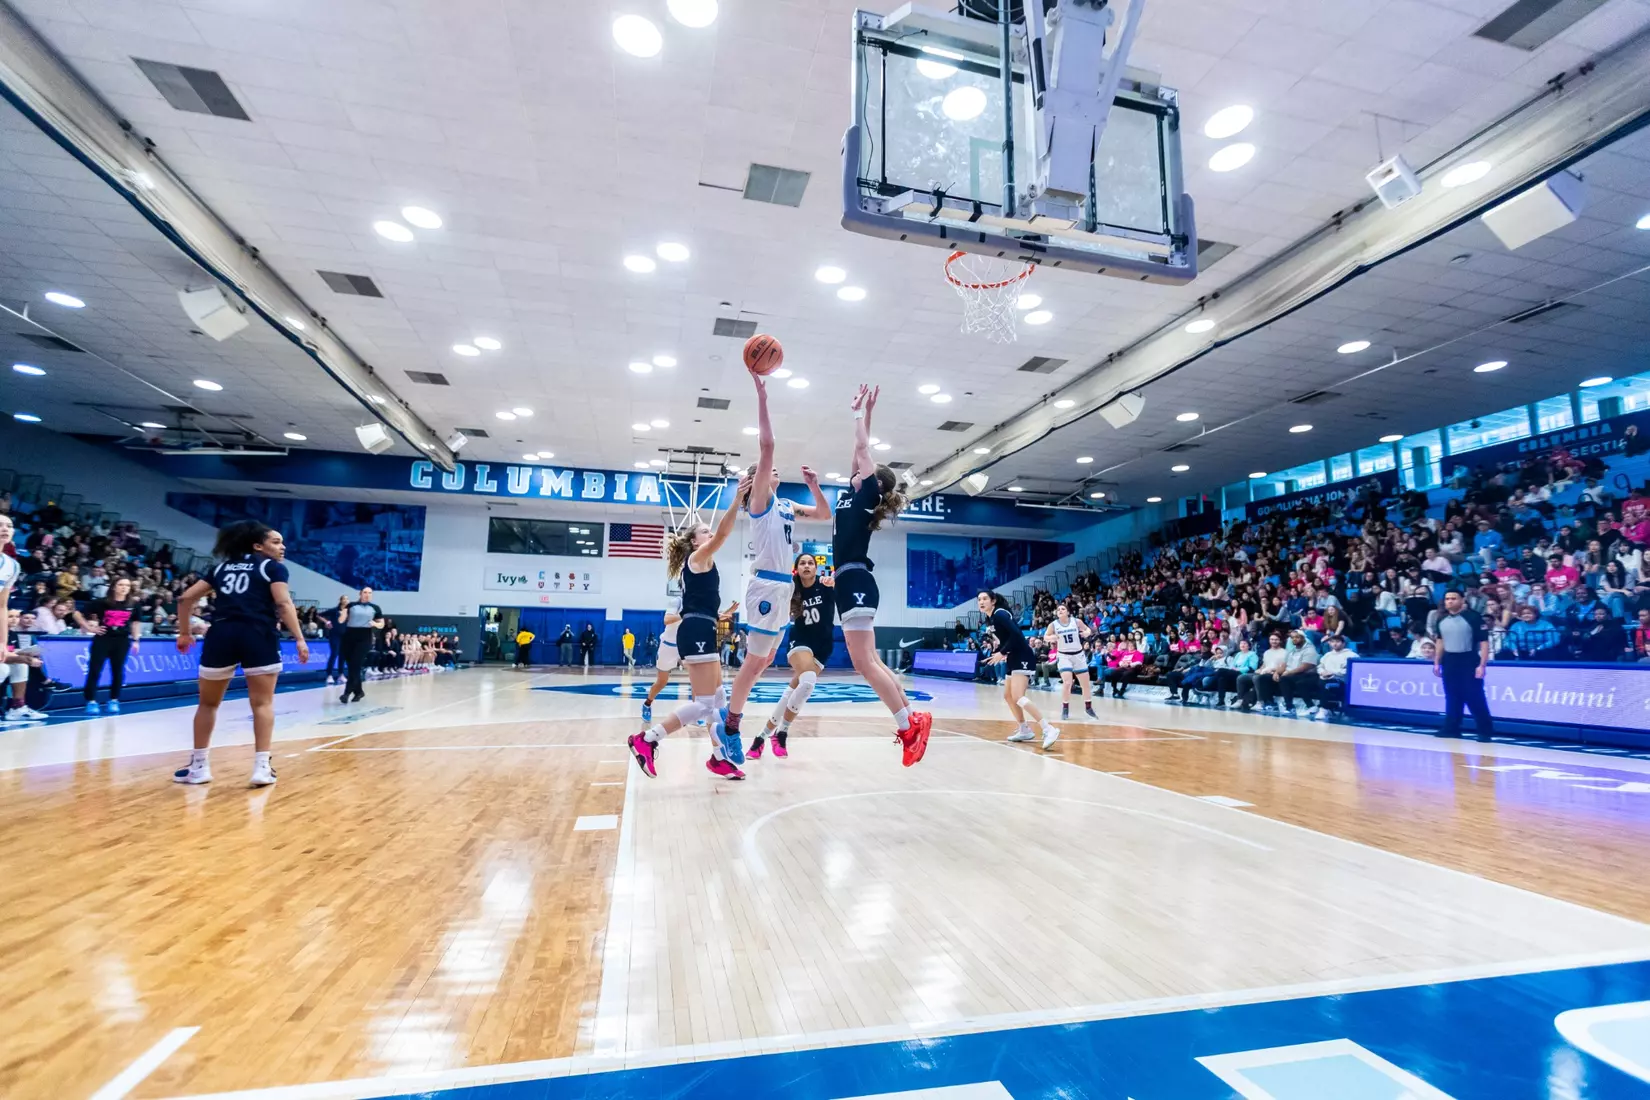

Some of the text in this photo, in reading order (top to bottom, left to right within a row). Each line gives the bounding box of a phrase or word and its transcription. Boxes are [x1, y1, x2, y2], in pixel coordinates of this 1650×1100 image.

[1518, 423, 1612, 453] COLUMBIA
[410, 460, 661, 502] COLUMBIA
[902, 494, 952, 513] ERE.
[220, 572, 250, 594] 30
[497, 573, 517, 586] Ivy
[802, 595, 823, 608] ALE
[853, 592, 866, 605] Y
[802, 607, 820, 625] 20
[695, 641, 706, 653] Y
[1063, 634, 1074, 644] 15
[125, 654, 198, 674] OLUMBI
[1021, 661, 1029, 669] Y
[1385, 679, 1617, 709] COLUIA alumni
